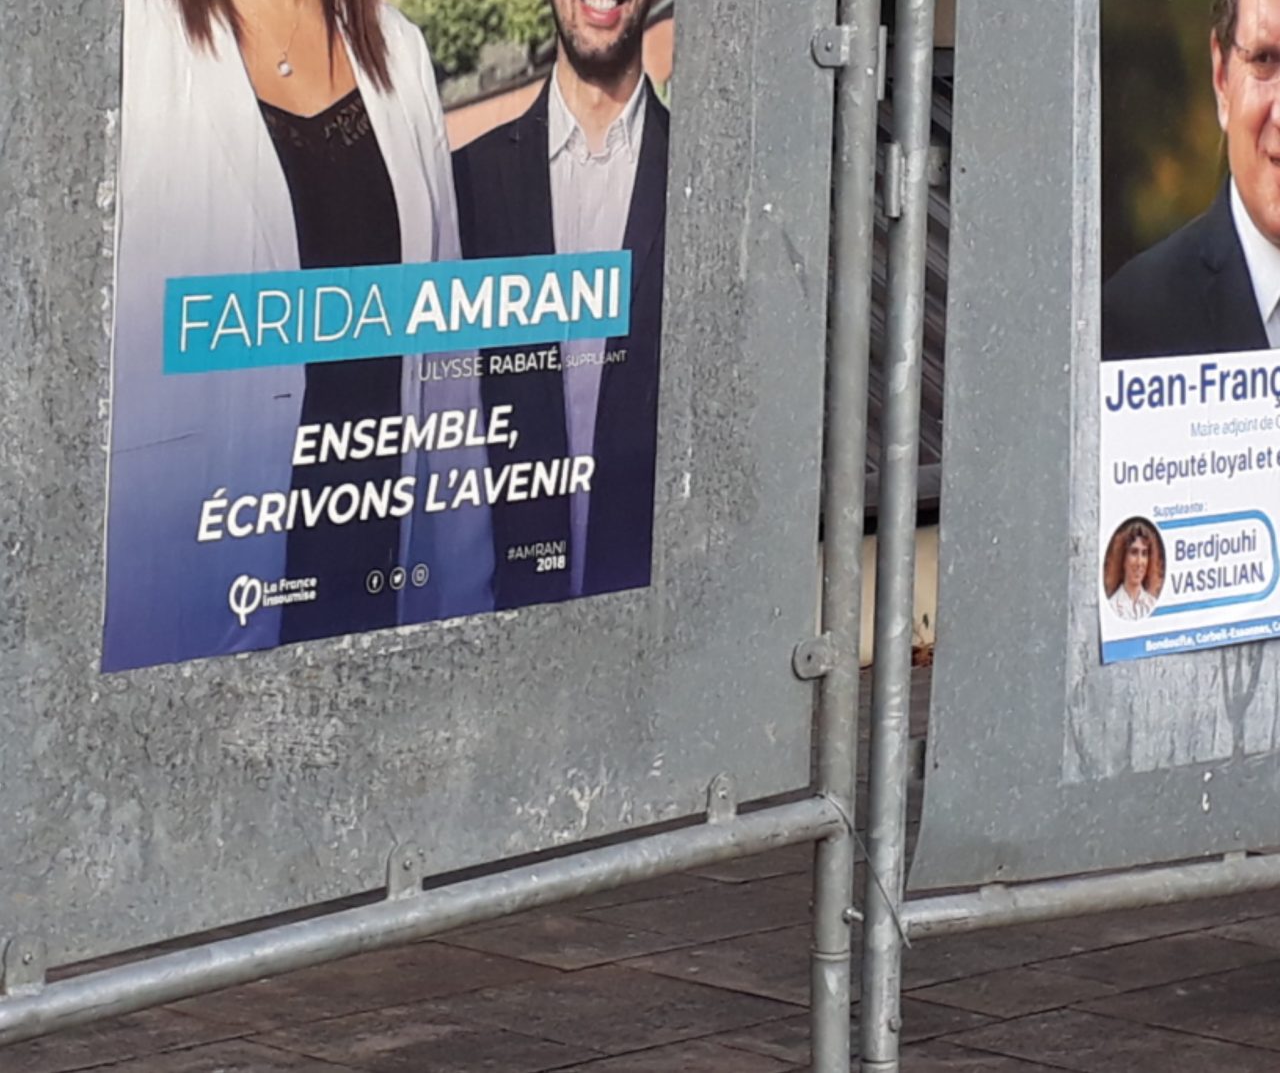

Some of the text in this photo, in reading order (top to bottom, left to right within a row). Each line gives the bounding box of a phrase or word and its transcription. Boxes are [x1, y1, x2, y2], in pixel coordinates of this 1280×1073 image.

[180, 267, 621, 352] FARIDA AMRANI
[418, 356, 484, 382] ULYSSE
[489, 347, 562, 376] RABATÉ,
[292, 405, 519, 466] ENSEMBLE,
[1260, 416, 1273, 430] de
[1114, 461, 1138, 484] Un
[1143, 453, 1207, 484] député
[1210, 447, 1253, 478] loyal
[1257, 447, 1273, 469] et
[197, 454, 595, 542] ÉCRIVONS L'AVENIR
[506, 540, 566, 562] #AMRANI
[1175, 529, 1257, 562] Berdjouhi
[536, 554, 565, 573] 2018
[1171, 562, 1265, 595] VASSILIAN
[262, 588, 317, 607] insoumise
[263, 576, 317, 594] La France
